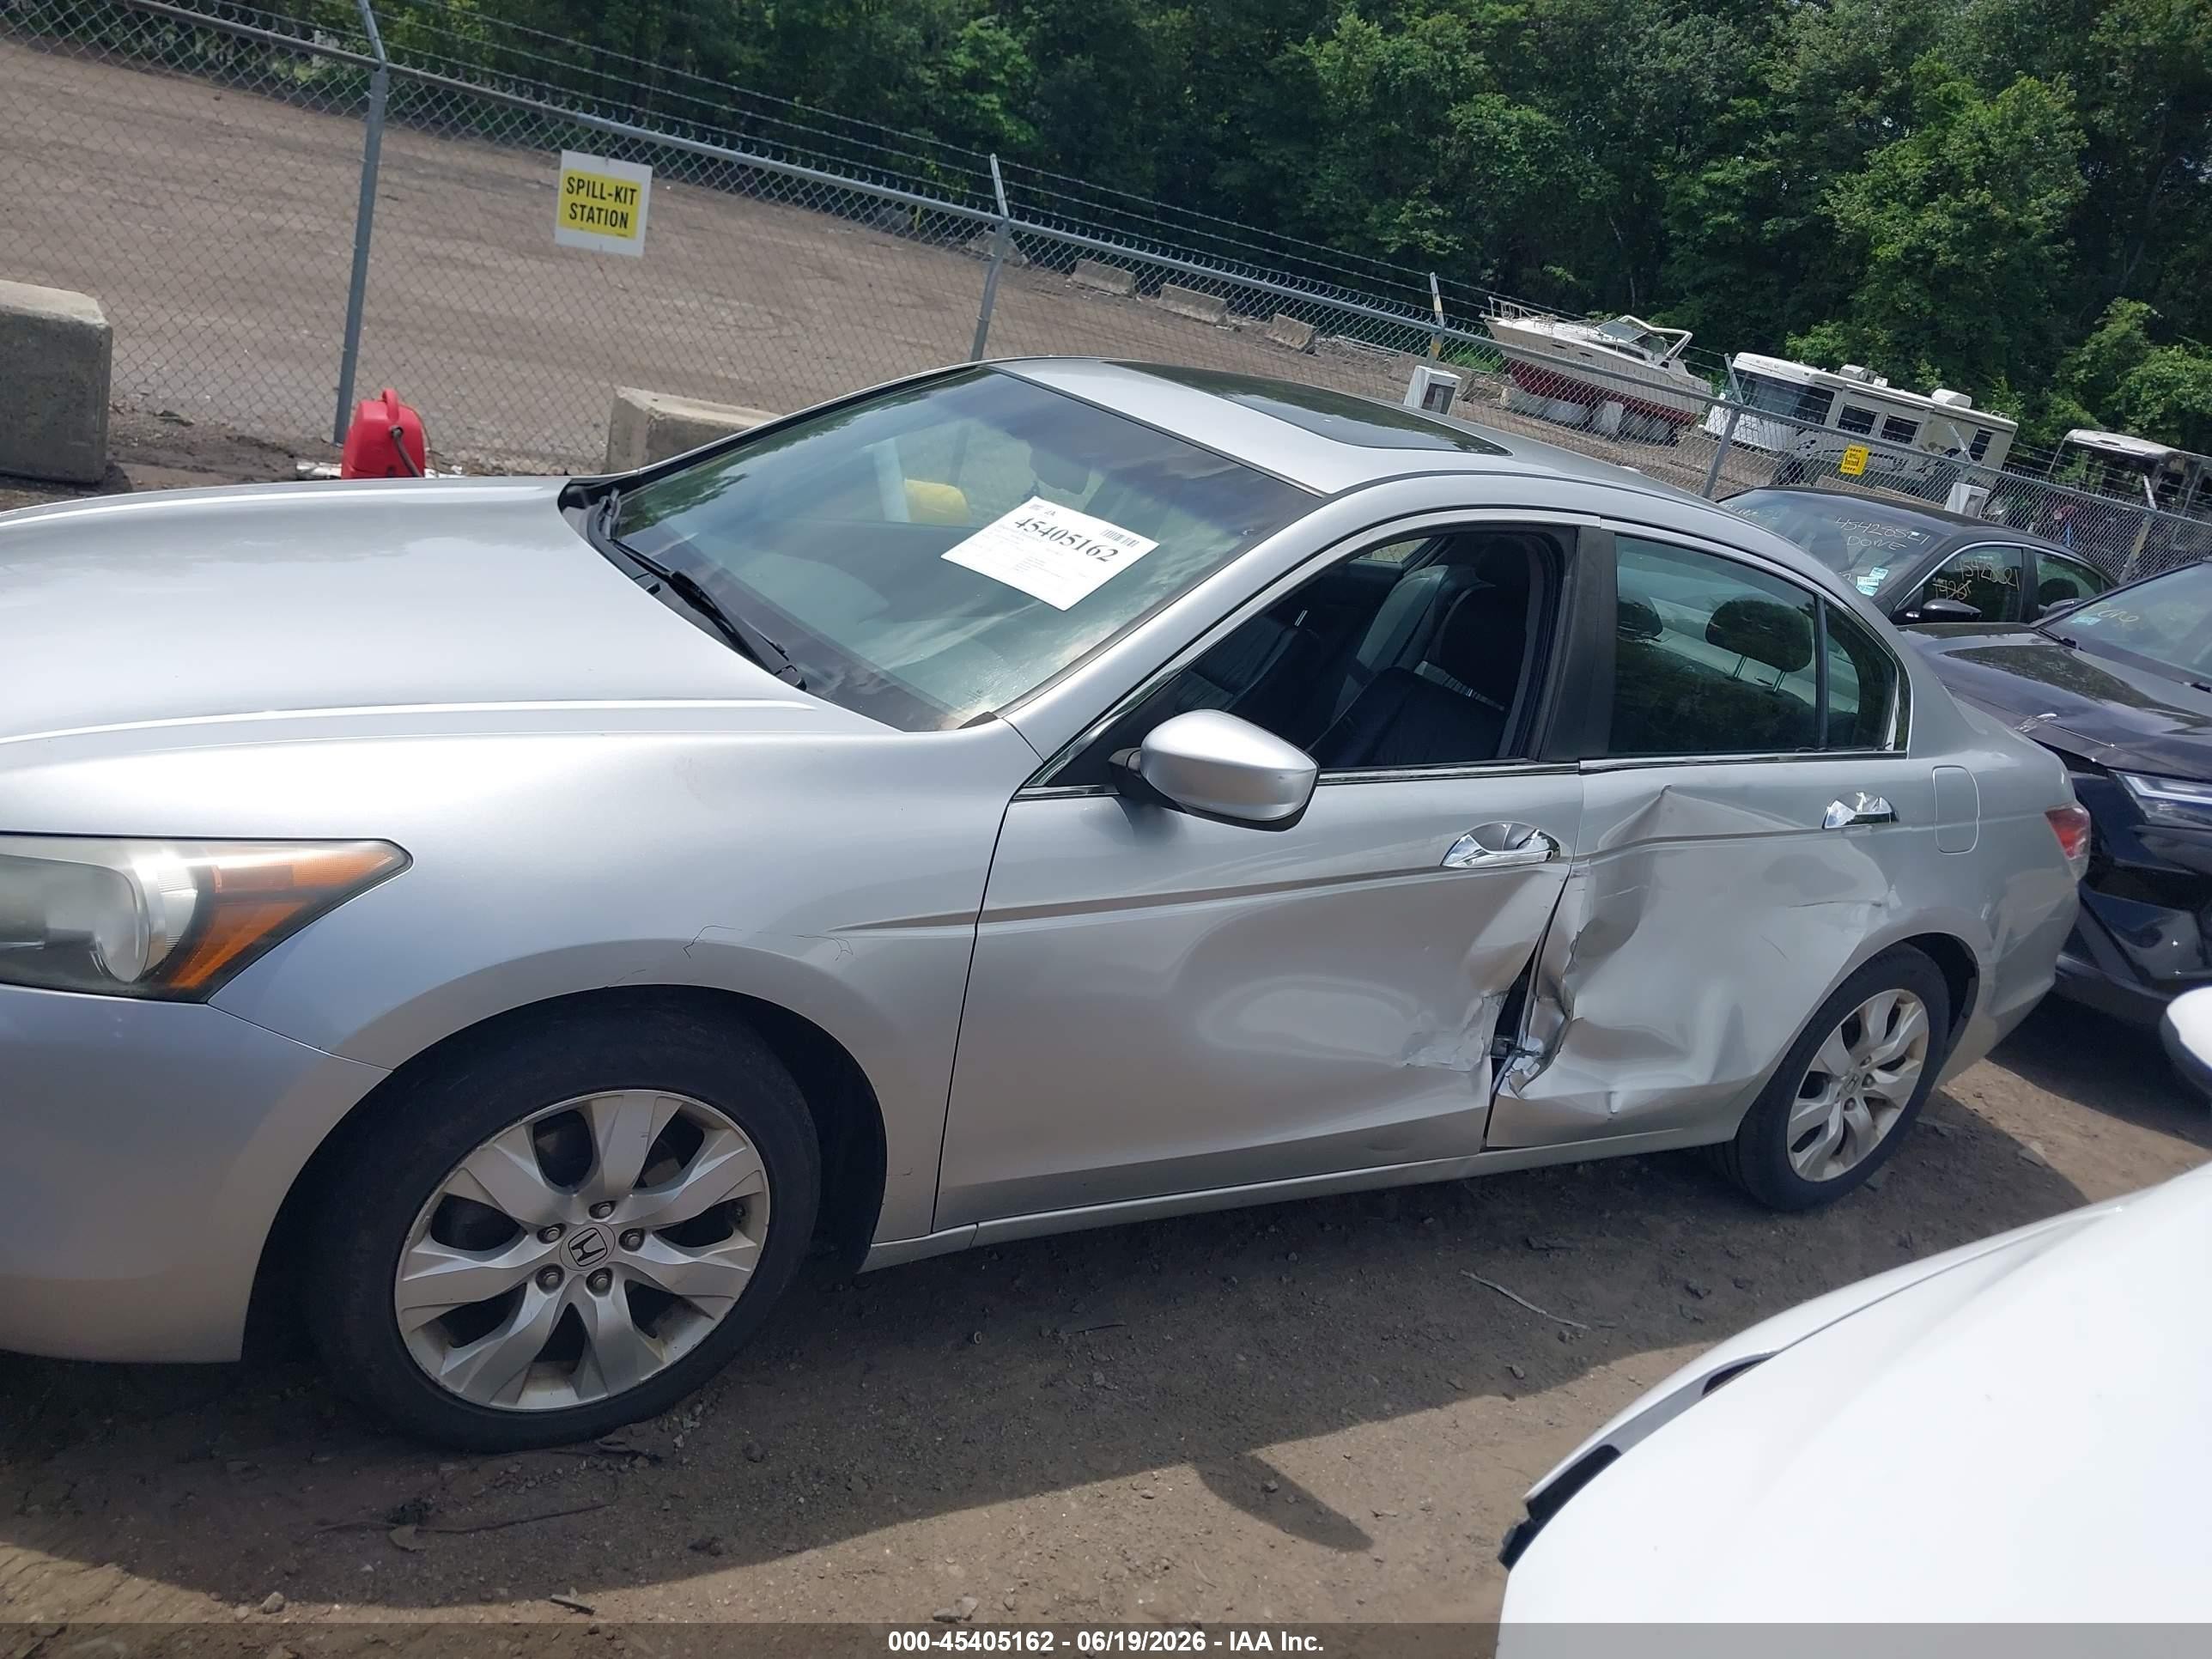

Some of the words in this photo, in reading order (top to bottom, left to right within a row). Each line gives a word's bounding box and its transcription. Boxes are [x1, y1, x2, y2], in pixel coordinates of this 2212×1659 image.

[566, 176, 637, 205] SPILL-KIT
[568, 202, 629, 229] STATION
[1014, 517, 1119, 562] 45405162
